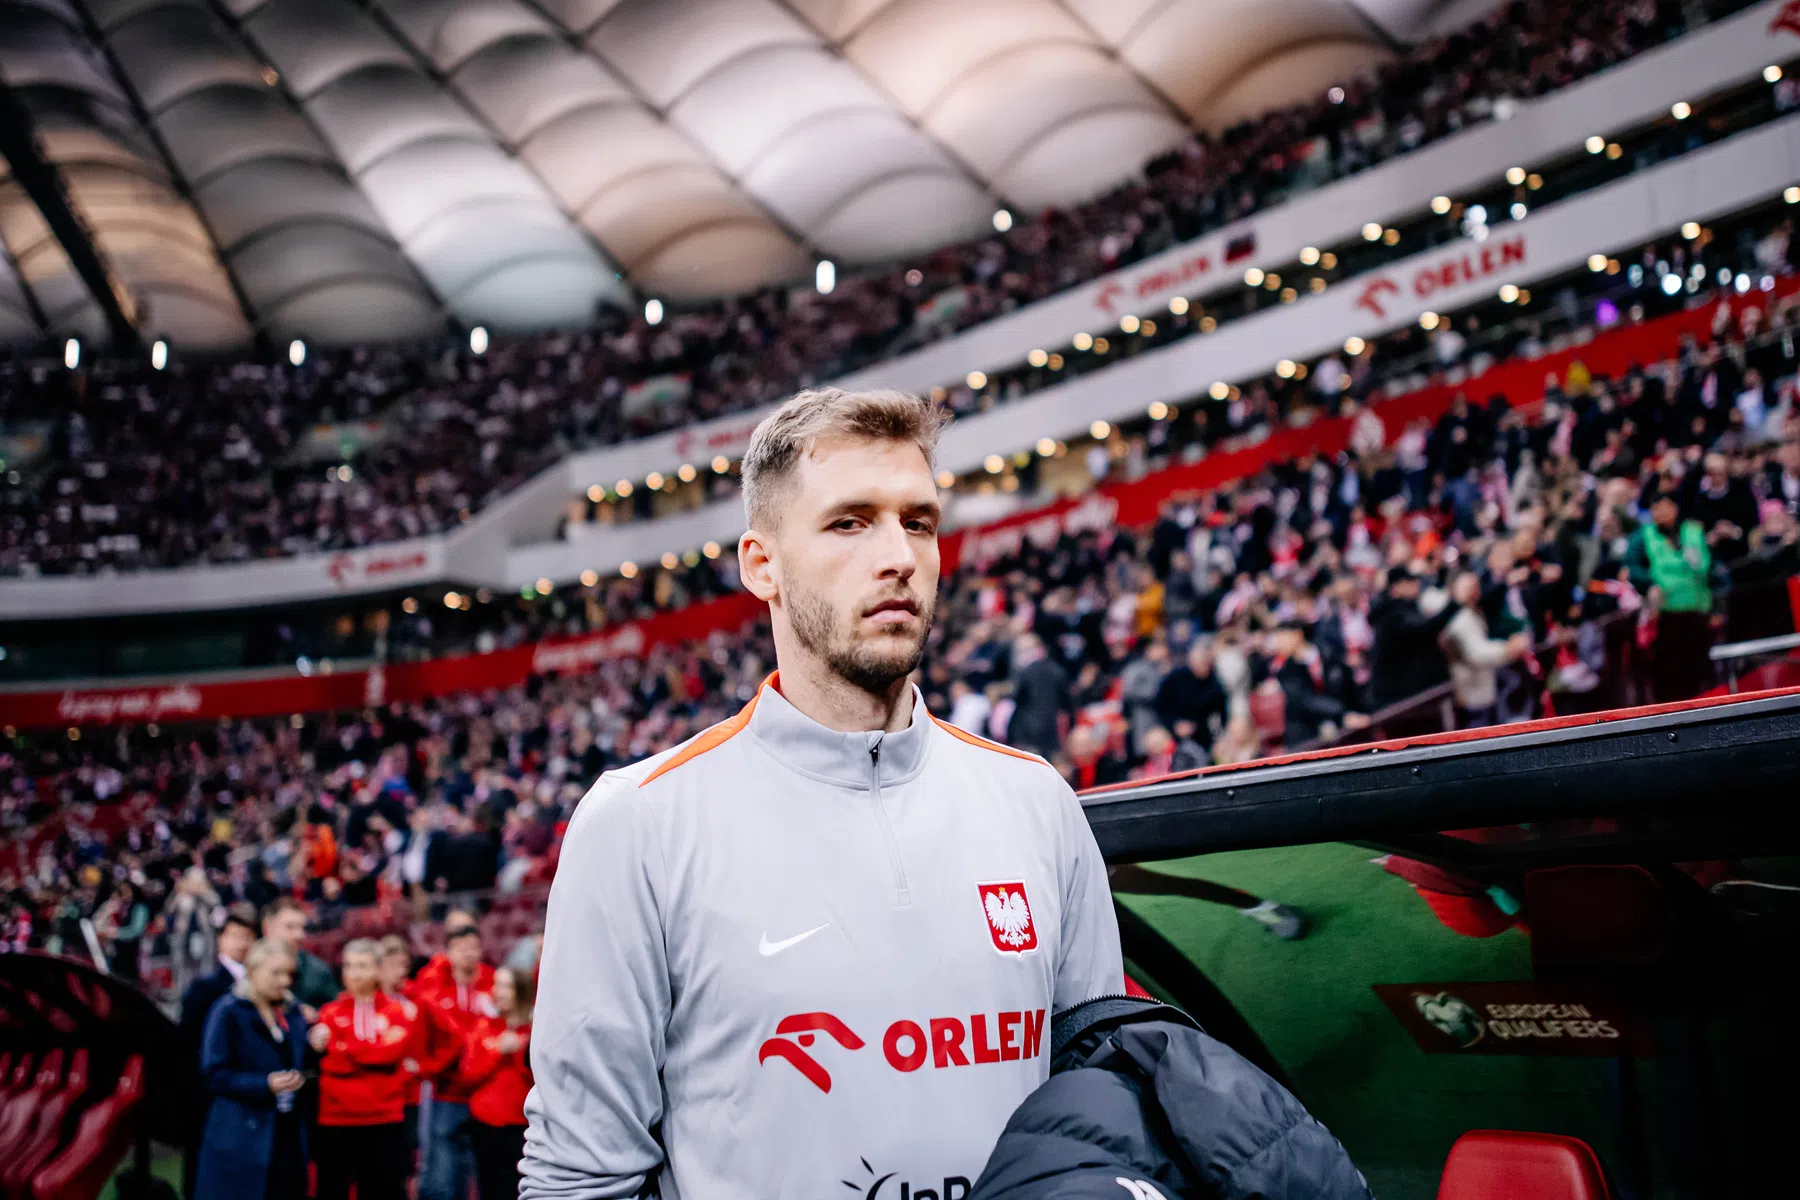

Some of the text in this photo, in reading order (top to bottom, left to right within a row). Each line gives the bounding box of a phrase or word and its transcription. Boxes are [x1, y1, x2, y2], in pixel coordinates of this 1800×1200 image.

[1486, 1003, 1592, 1019] EUROPEAN
[1487, 1020, 1621, 1040] QUALIFIERS
[882, 1009, 1046, 1073] ORLEN
